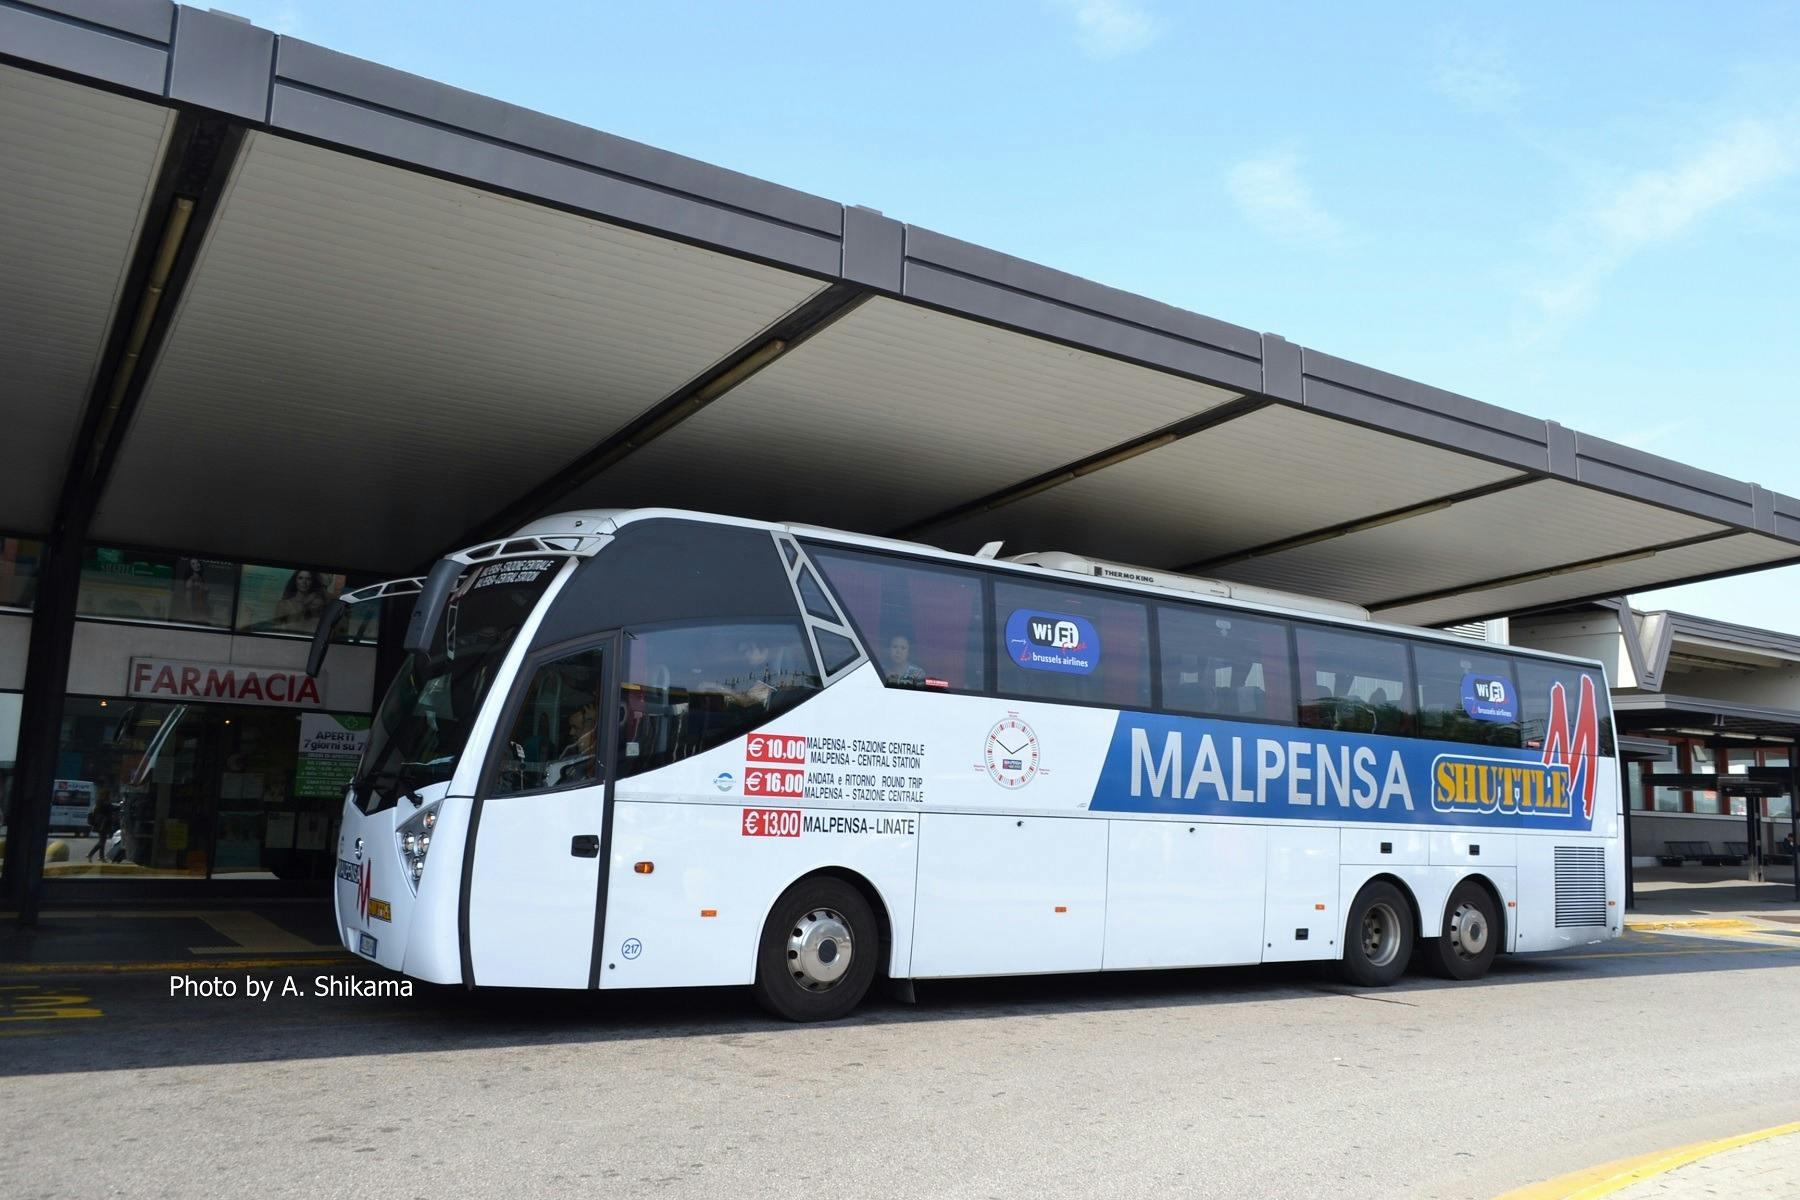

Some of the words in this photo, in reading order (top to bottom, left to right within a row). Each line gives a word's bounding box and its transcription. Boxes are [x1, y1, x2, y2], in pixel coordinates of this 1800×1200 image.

[1104, 570, 1135, 580] THERMO
[1032, 652, 1062, 664] brussels
[1063, 656, 1089, 667] airlines
[134, 663, 320, 704] FARMACIA
[316, 731, 355, 742] APERTI
[807, 737, 846, 751] MALPENSA
[852, 740, 886, 754] STAZIONE
[888, 742, 925, 756] CENTRALE
[811, 751, 850, 765] MALPENSA
[857, 754, 890, 767] CENTRAL
[892, 756, 921, 769] STATION
[1130, 727, 1414, 811] MALPENSA
[1437, 762, 1569, 809] SHUTTLE
[807, 772, 835, 785] ANDATA
[838, 776, 843, 785] e
[845, 774, 876, 787] RITORNO
[882, 776, 906, 788] ROUND
[908, 777, 923, 788] TRIP
[804, 786, 843, 799] MALPENSA
[852, 788, 886, 801] STAZIONE
[887, 789, 924, 802] CENTRALE
[624, 944, 640, 954] 217
